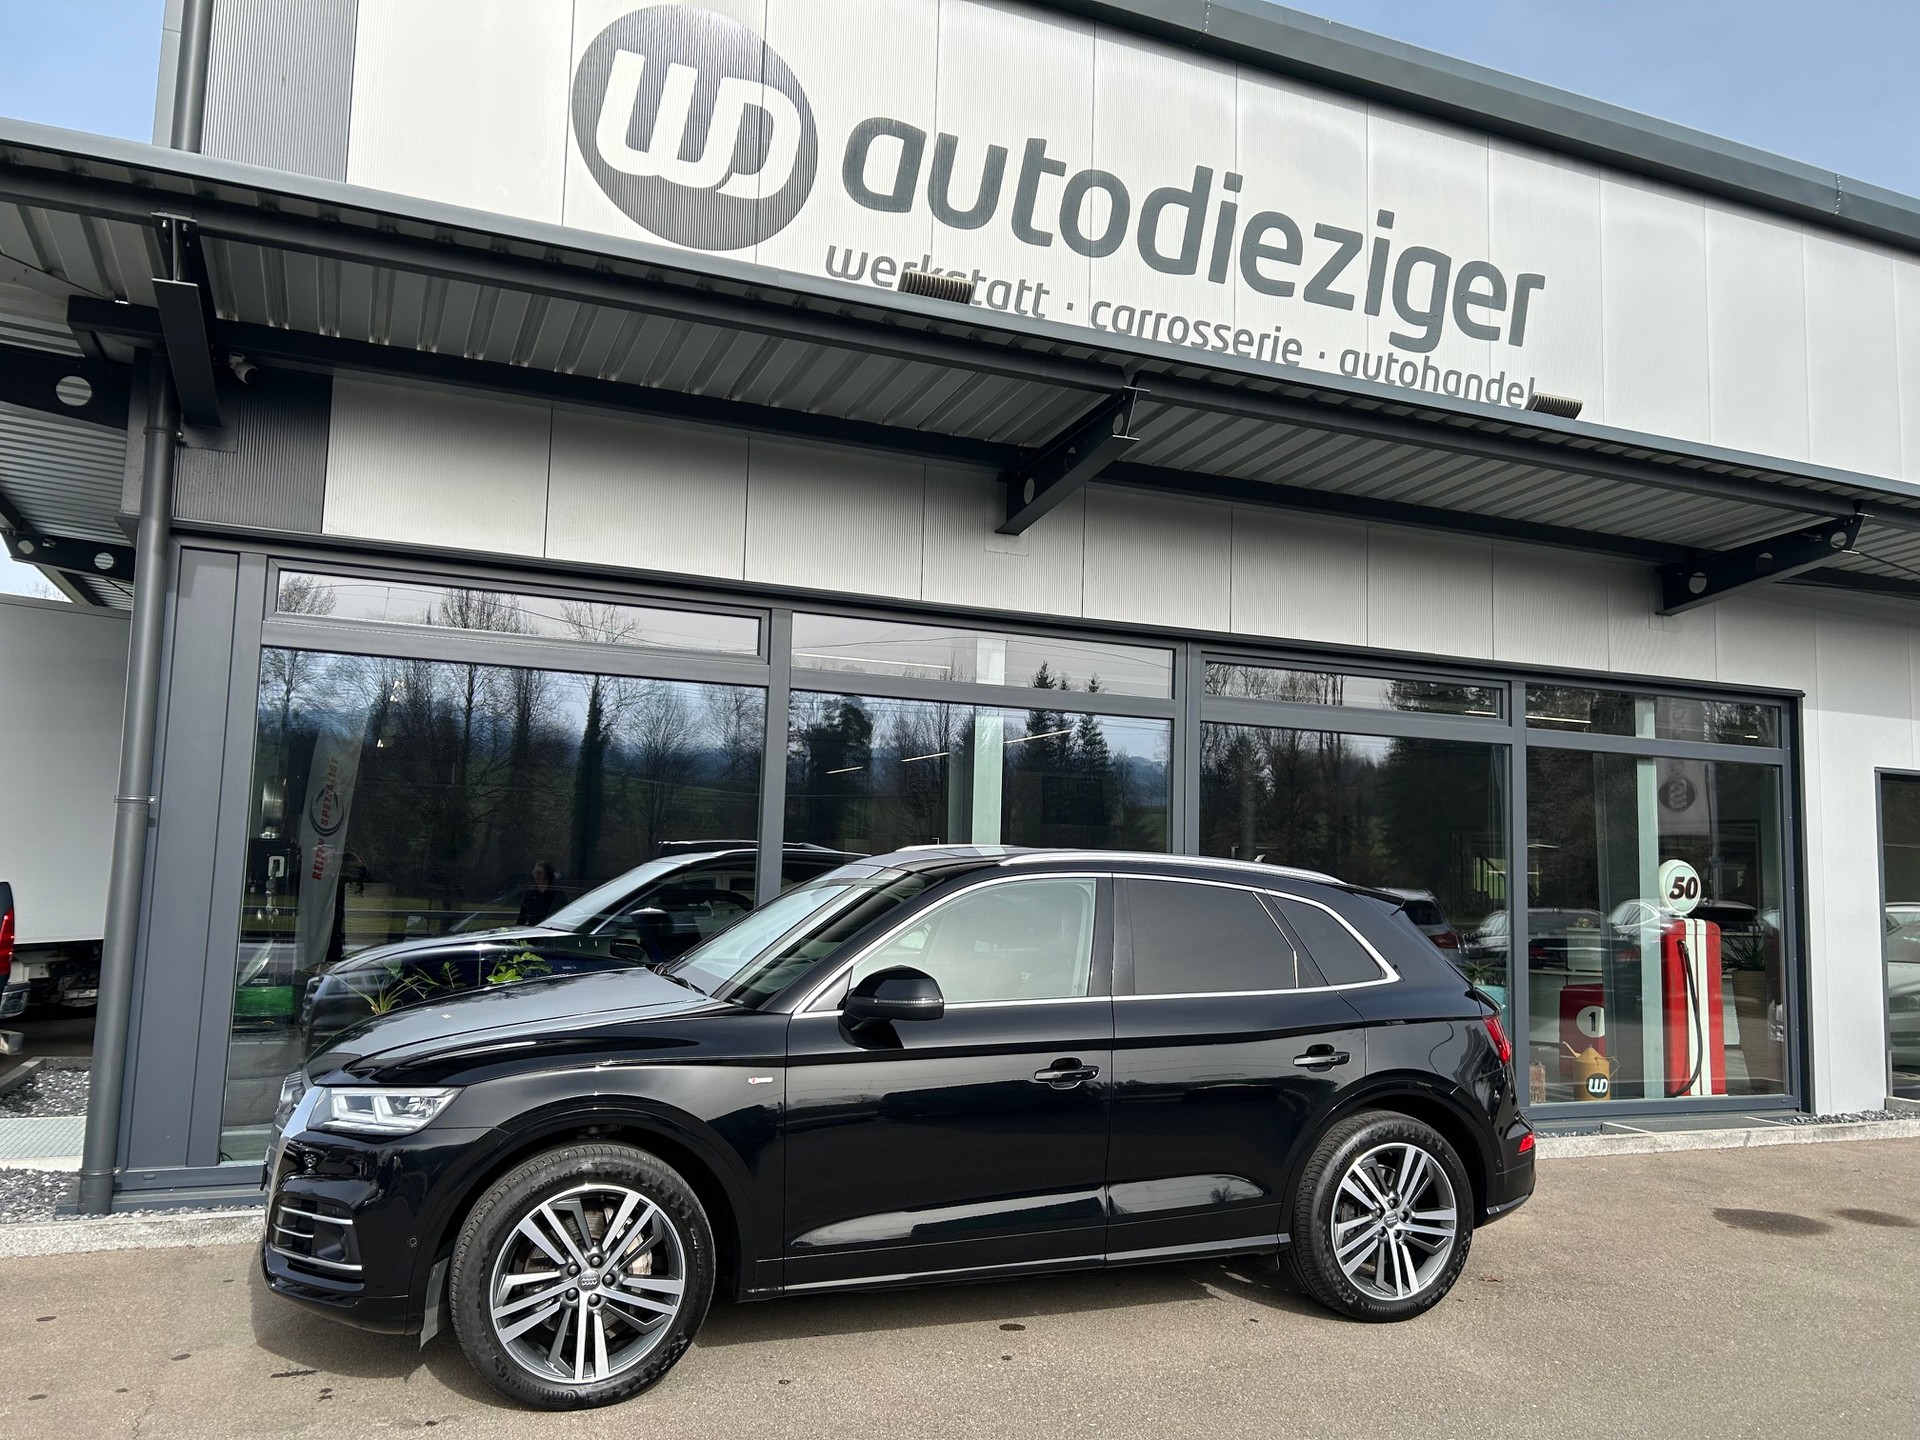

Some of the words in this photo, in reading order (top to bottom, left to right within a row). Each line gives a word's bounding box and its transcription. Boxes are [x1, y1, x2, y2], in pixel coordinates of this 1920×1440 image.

[842, 116, 1546, 353] autodieziger
[1091, 300, 1303, 367] carrosserie
[1339, 348, 1536, 408] autohandel
[1669, 876, 1698, 900] 50
[1588, 1011, 1597, 1032] 1
